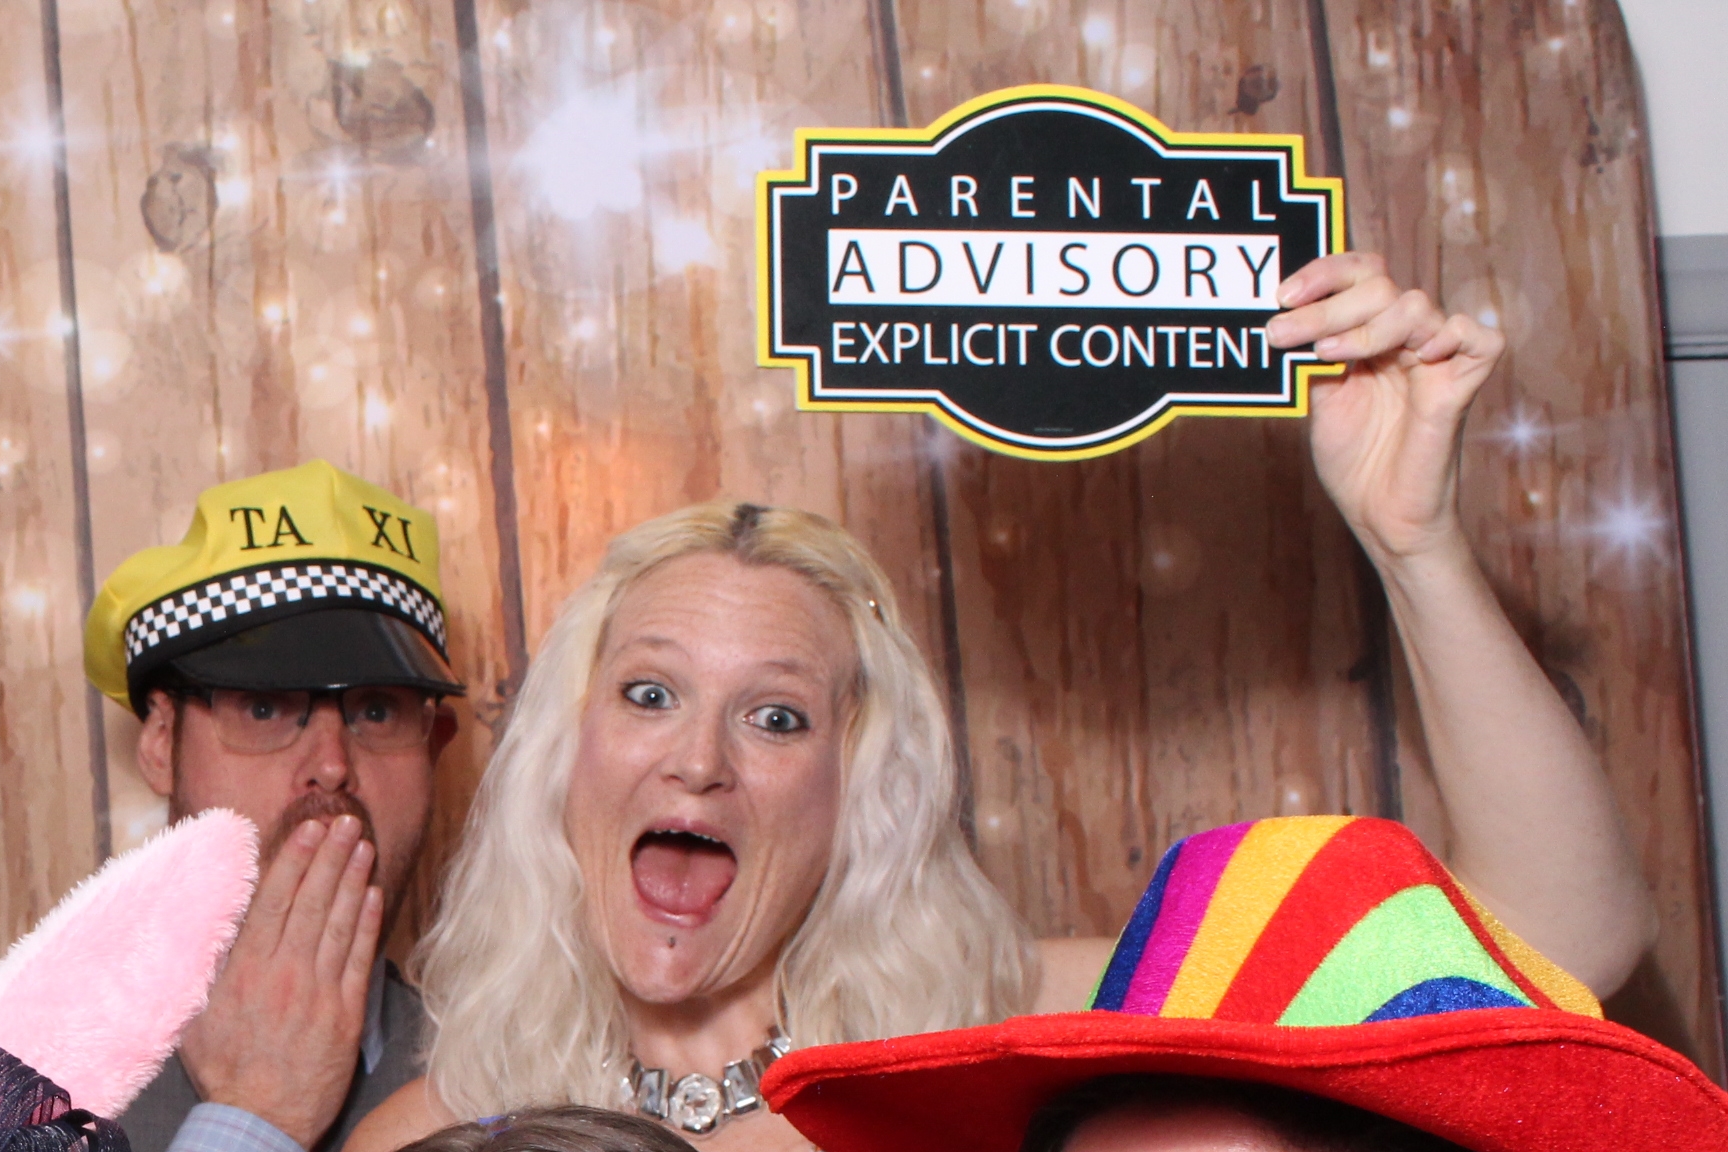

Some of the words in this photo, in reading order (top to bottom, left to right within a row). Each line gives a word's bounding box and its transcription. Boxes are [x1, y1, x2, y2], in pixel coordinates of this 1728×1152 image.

[831, 173, 1277, 222] PARENTAL
[832, 239, 1278, 299] ADVISORY
[832, 321, 1038, 366] EXPLICIT
[1050, 323, 1270, 369] CONTENT
